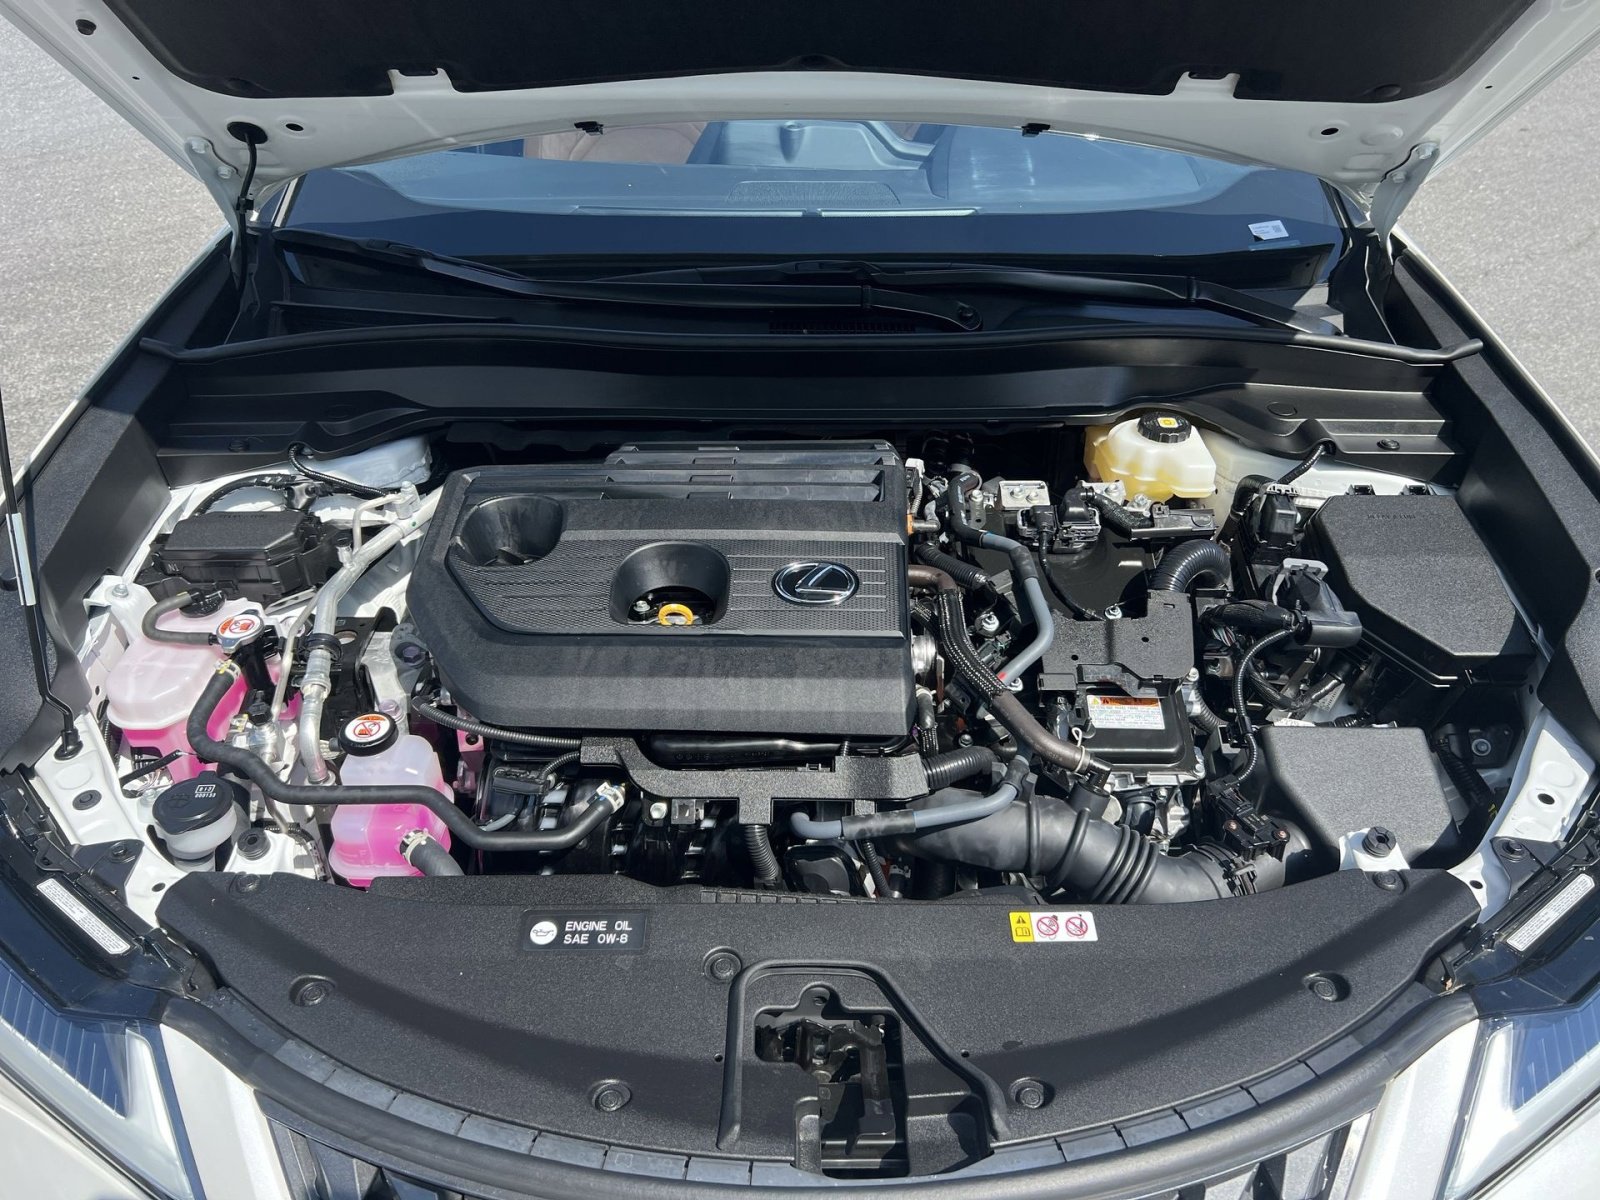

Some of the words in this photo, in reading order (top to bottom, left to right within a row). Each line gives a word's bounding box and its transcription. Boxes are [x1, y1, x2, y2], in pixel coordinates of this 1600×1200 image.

[565, 920, 608, 931] ENGINE
[614, 920, 633, 931] OIL
[563, 933, 590, 944] SAE
[597, 933, 629, 944] 0W-8
